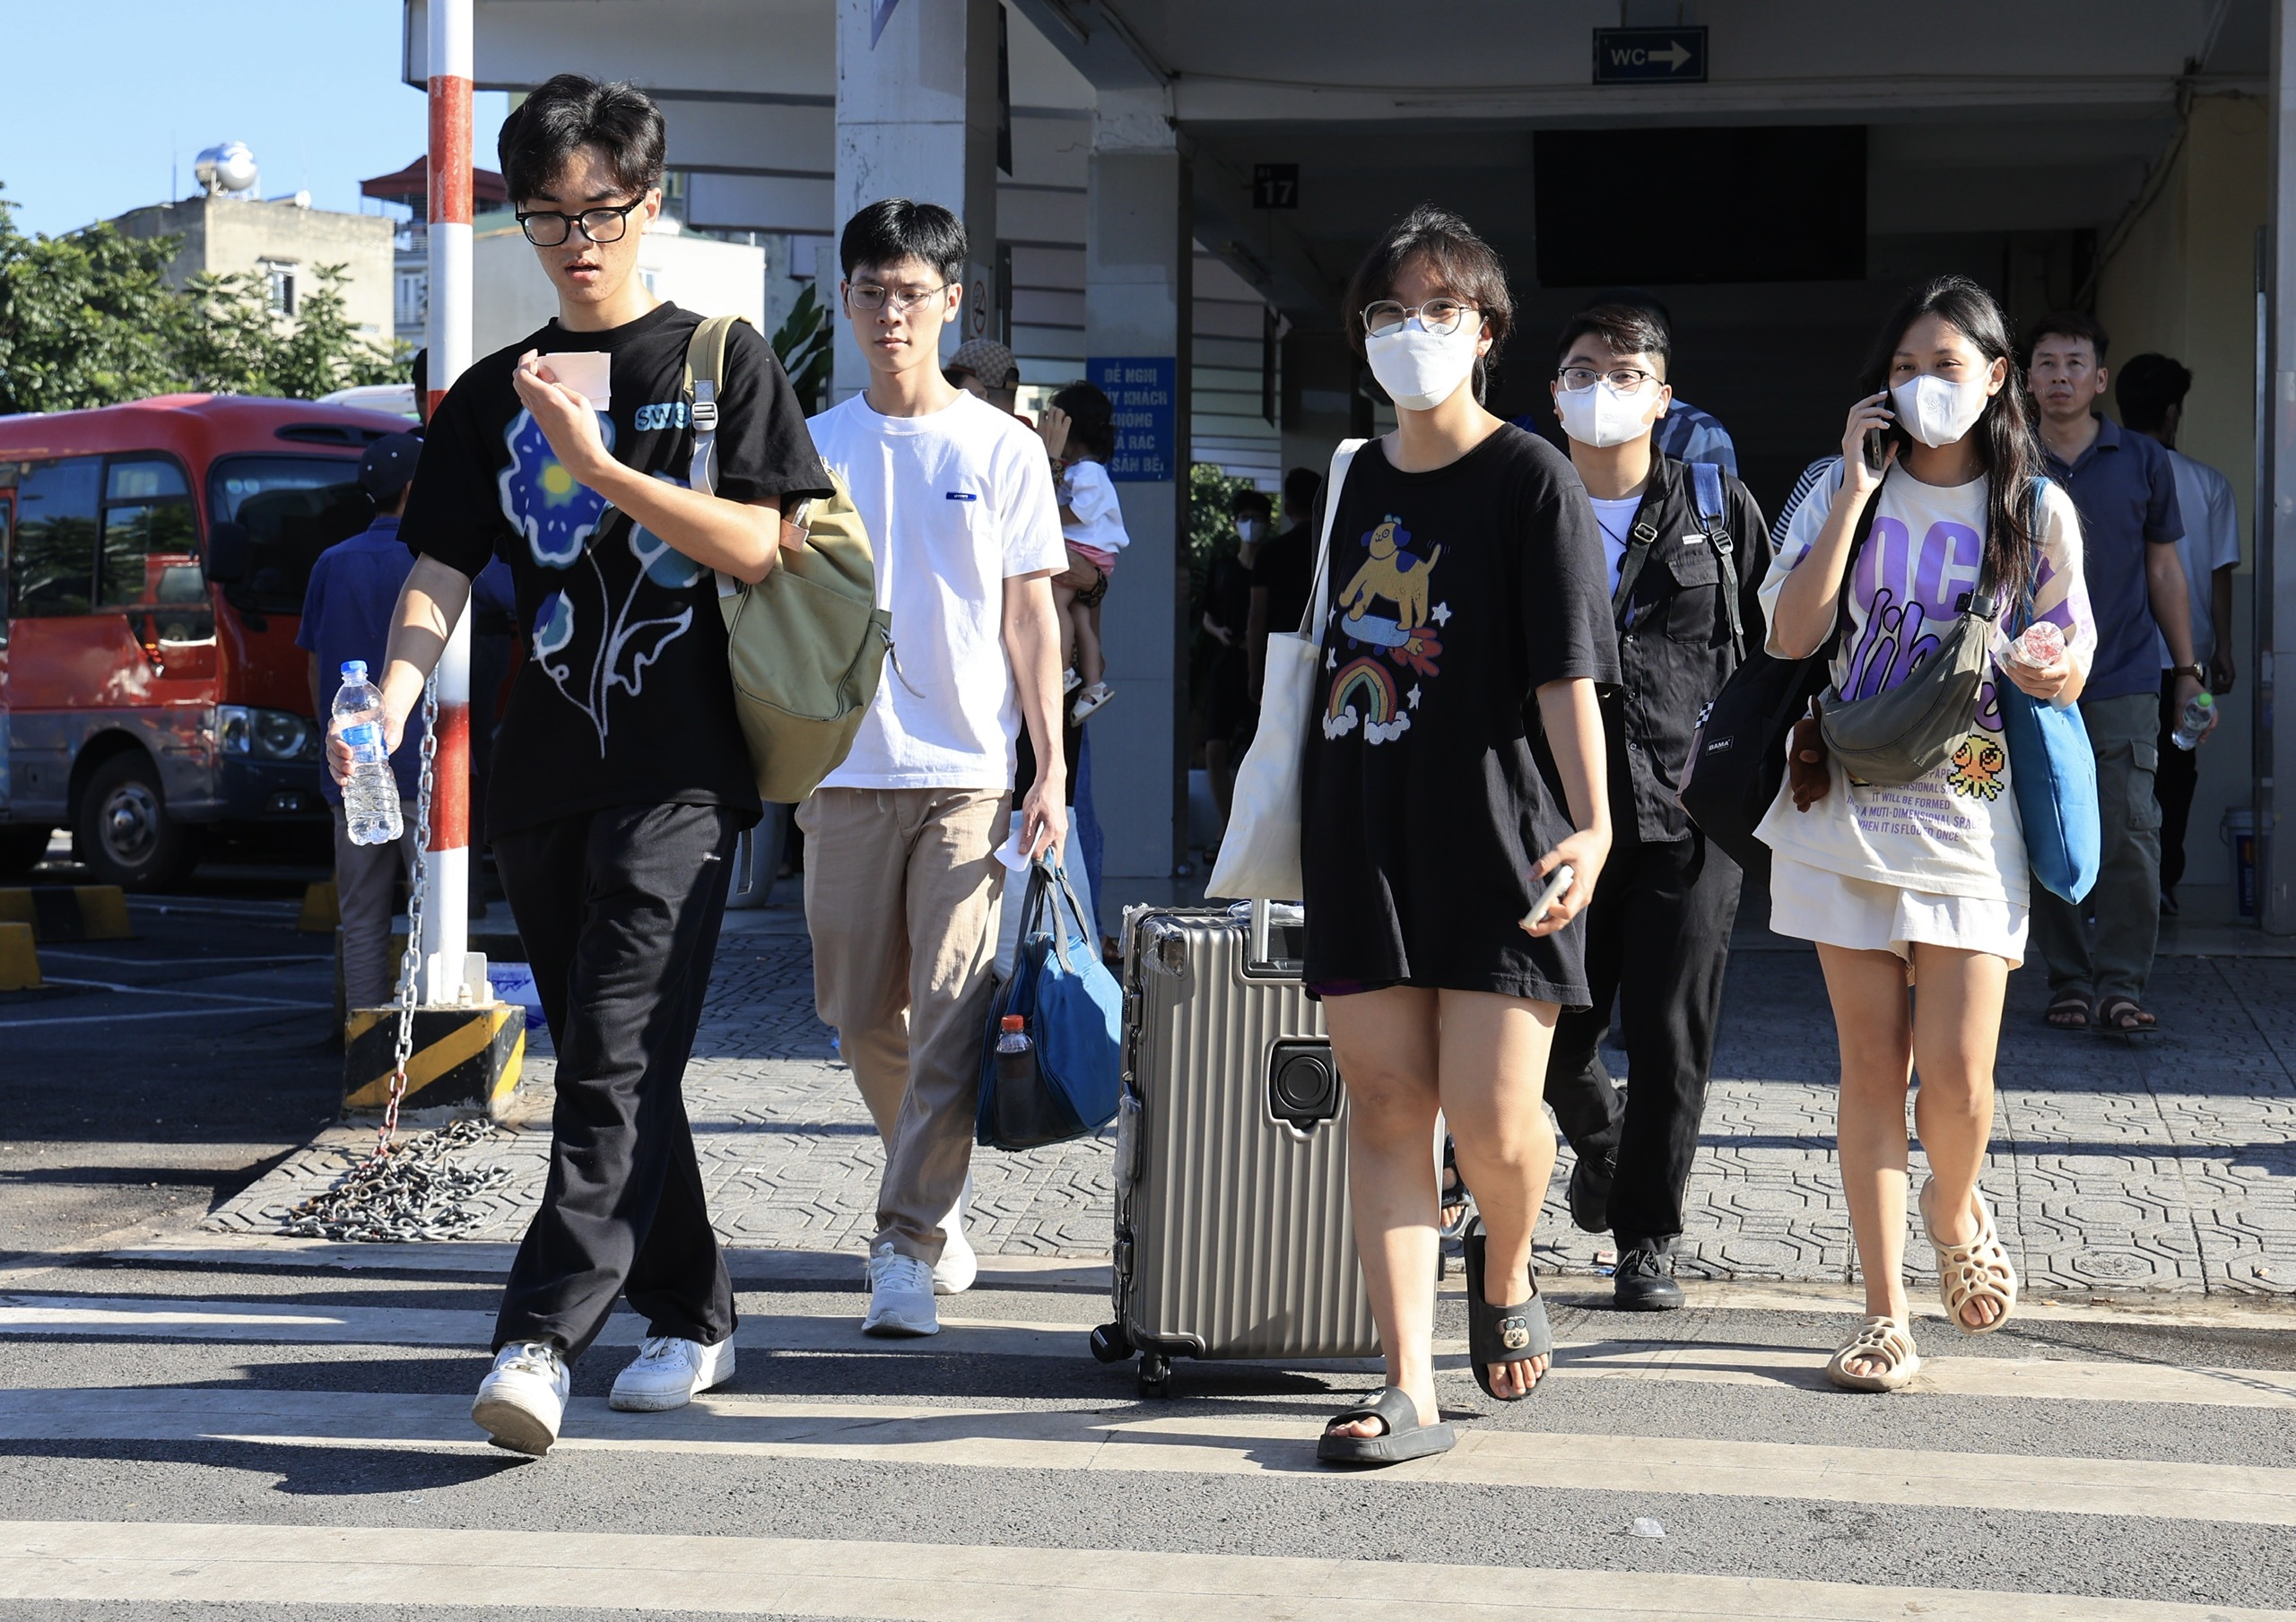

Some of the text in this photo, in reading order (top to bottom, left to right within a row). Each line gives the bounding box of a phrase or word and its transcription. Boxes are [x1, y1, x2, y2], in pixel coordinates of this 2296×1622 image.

[1611, 48, 1646, 65] WC
[1263, 180, 1293, 204] 17
[1125, 369, 1157, 386] NGHỊ
[1124, 387, 1168, 405] KHÁCH
[1128, 431, 1155, 449] RÁC
[1709, 741, 1730, 751] BAMA
[1872, 792, 1951, 810] IT WILL BE FORMED
[1861, 806, 1867, 817] A
[1881, 821, 1890, 833] IT
[1891, 823, 1900, 834] IS
[1935, 828, 1960, 842] ONCE
